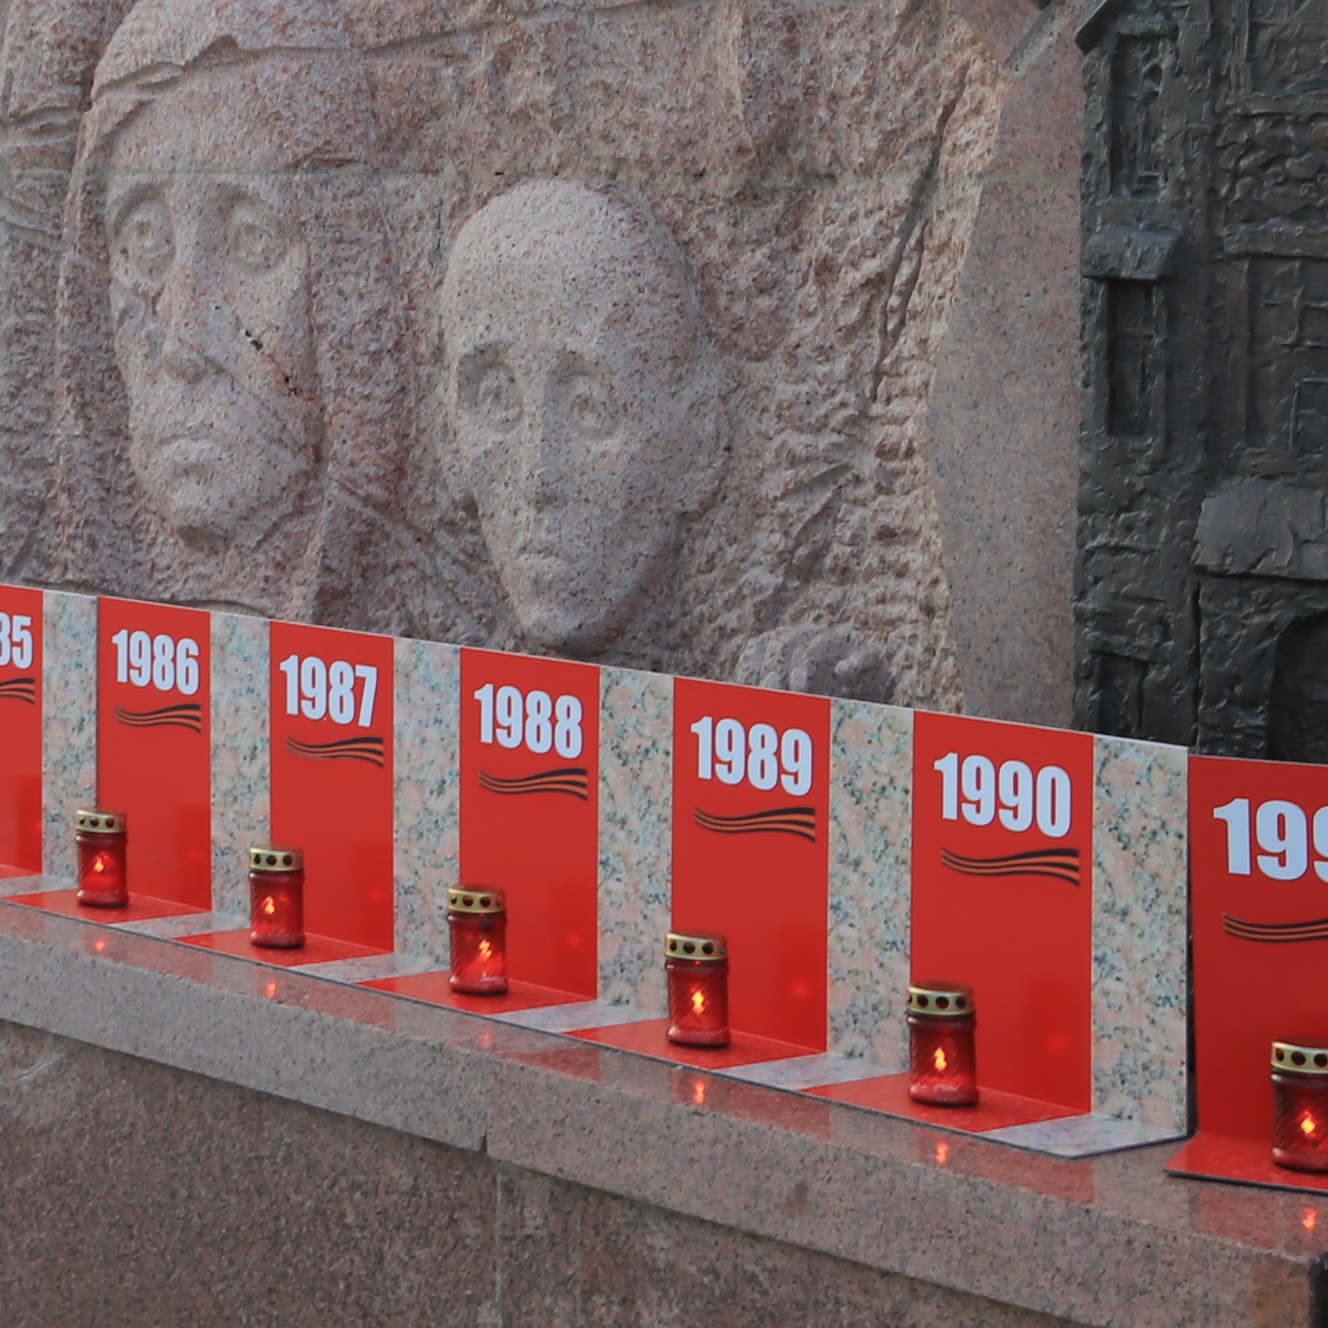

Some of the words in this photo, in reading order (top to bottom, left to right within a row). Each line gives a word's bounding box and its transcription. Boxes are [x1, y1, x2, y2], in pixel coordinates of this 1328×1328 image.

[111, 628, 200, 696] 1986
[279, 653, 378, 728] 1987
[473, 683, 584, 760] 1988
[690, 716, 814, 797] 1989
[933, 752, 1072, 839] 1990
[1213, 798, 1328, 884] 19
